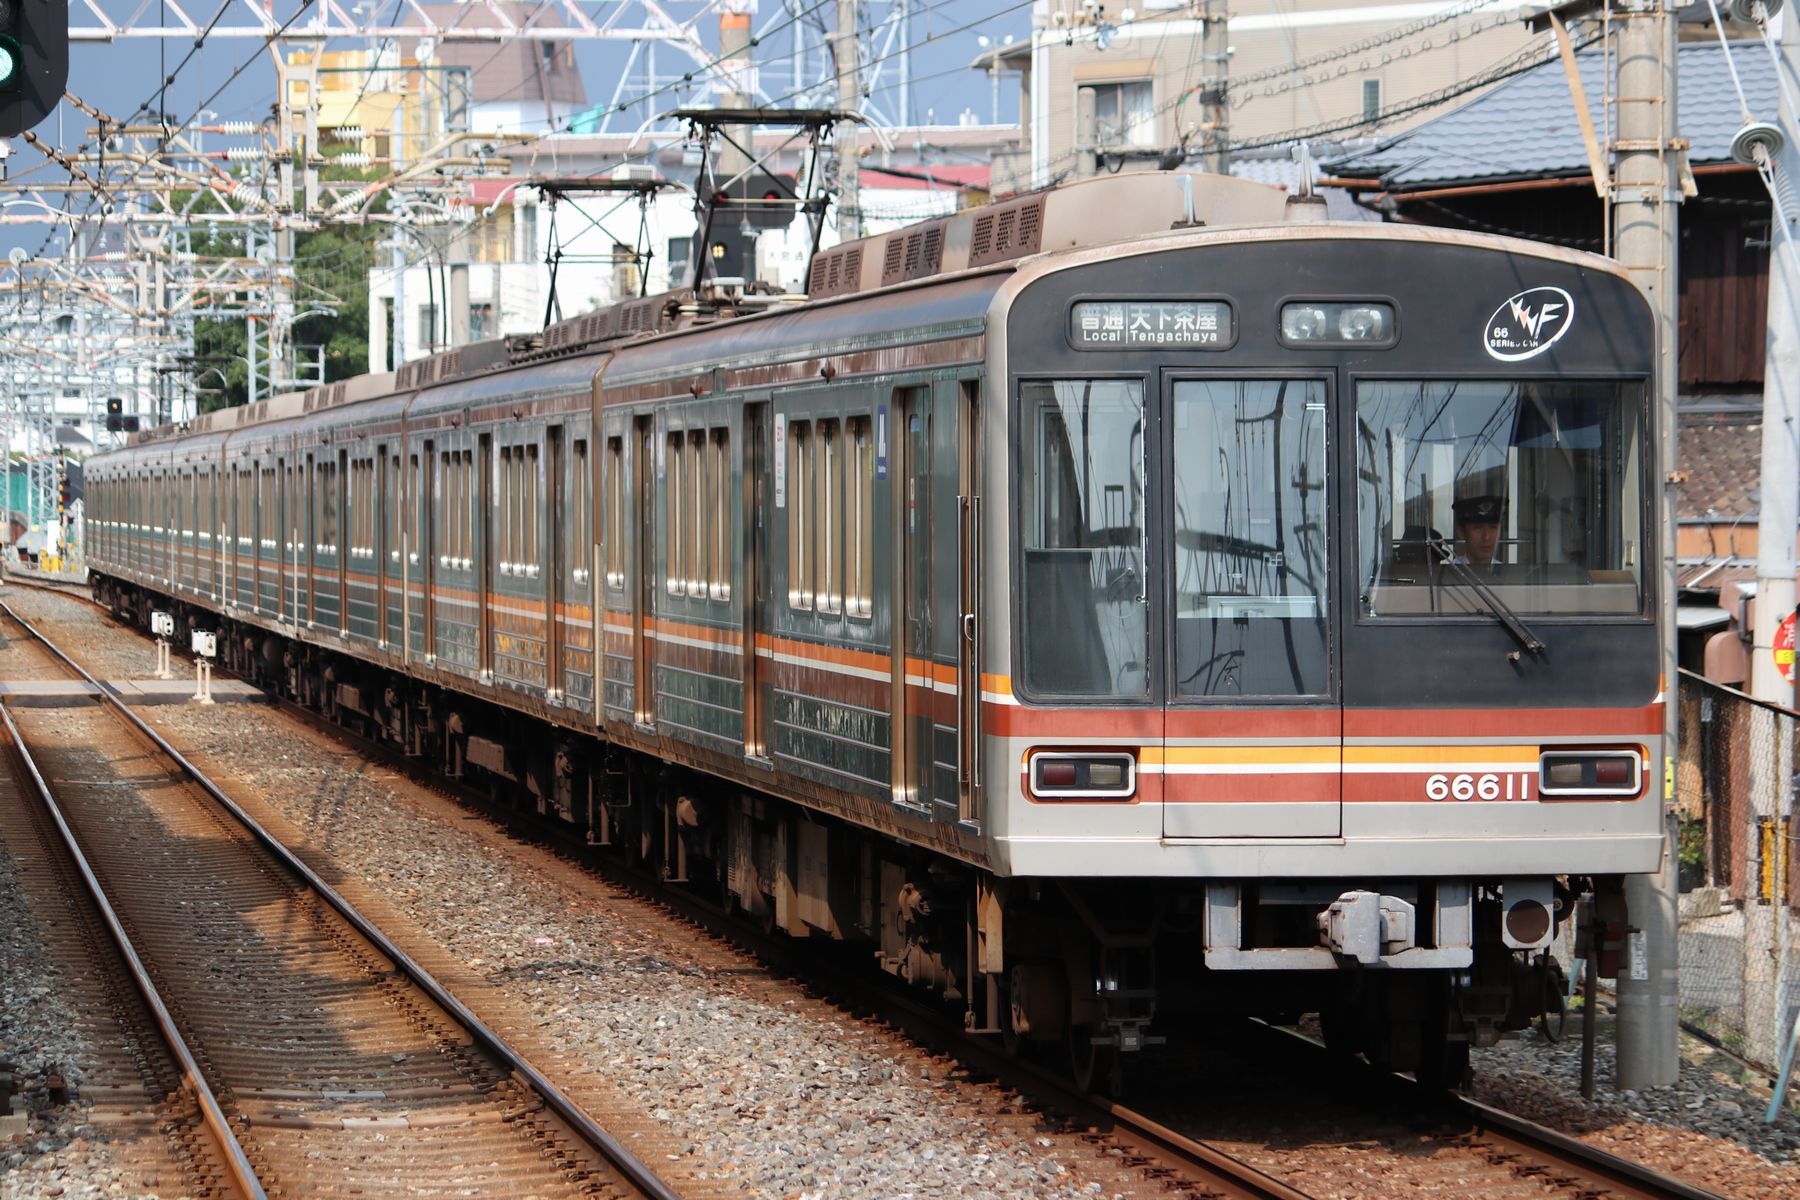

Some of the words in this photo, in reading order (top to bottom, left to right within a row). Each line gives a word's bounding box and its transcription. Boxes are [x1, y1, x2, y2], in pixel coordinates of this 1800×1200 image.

[1080, 304, 1123, 330] 普通
[1129, 304, 1217, 330] 天下茶屋
[1083, 330, 1121, 342] Local
[1130, 330, 1218, 343] Tengachaya
[1494, 328, 1508, 338] 66
[1425, 773, 1529, 801] 66611
